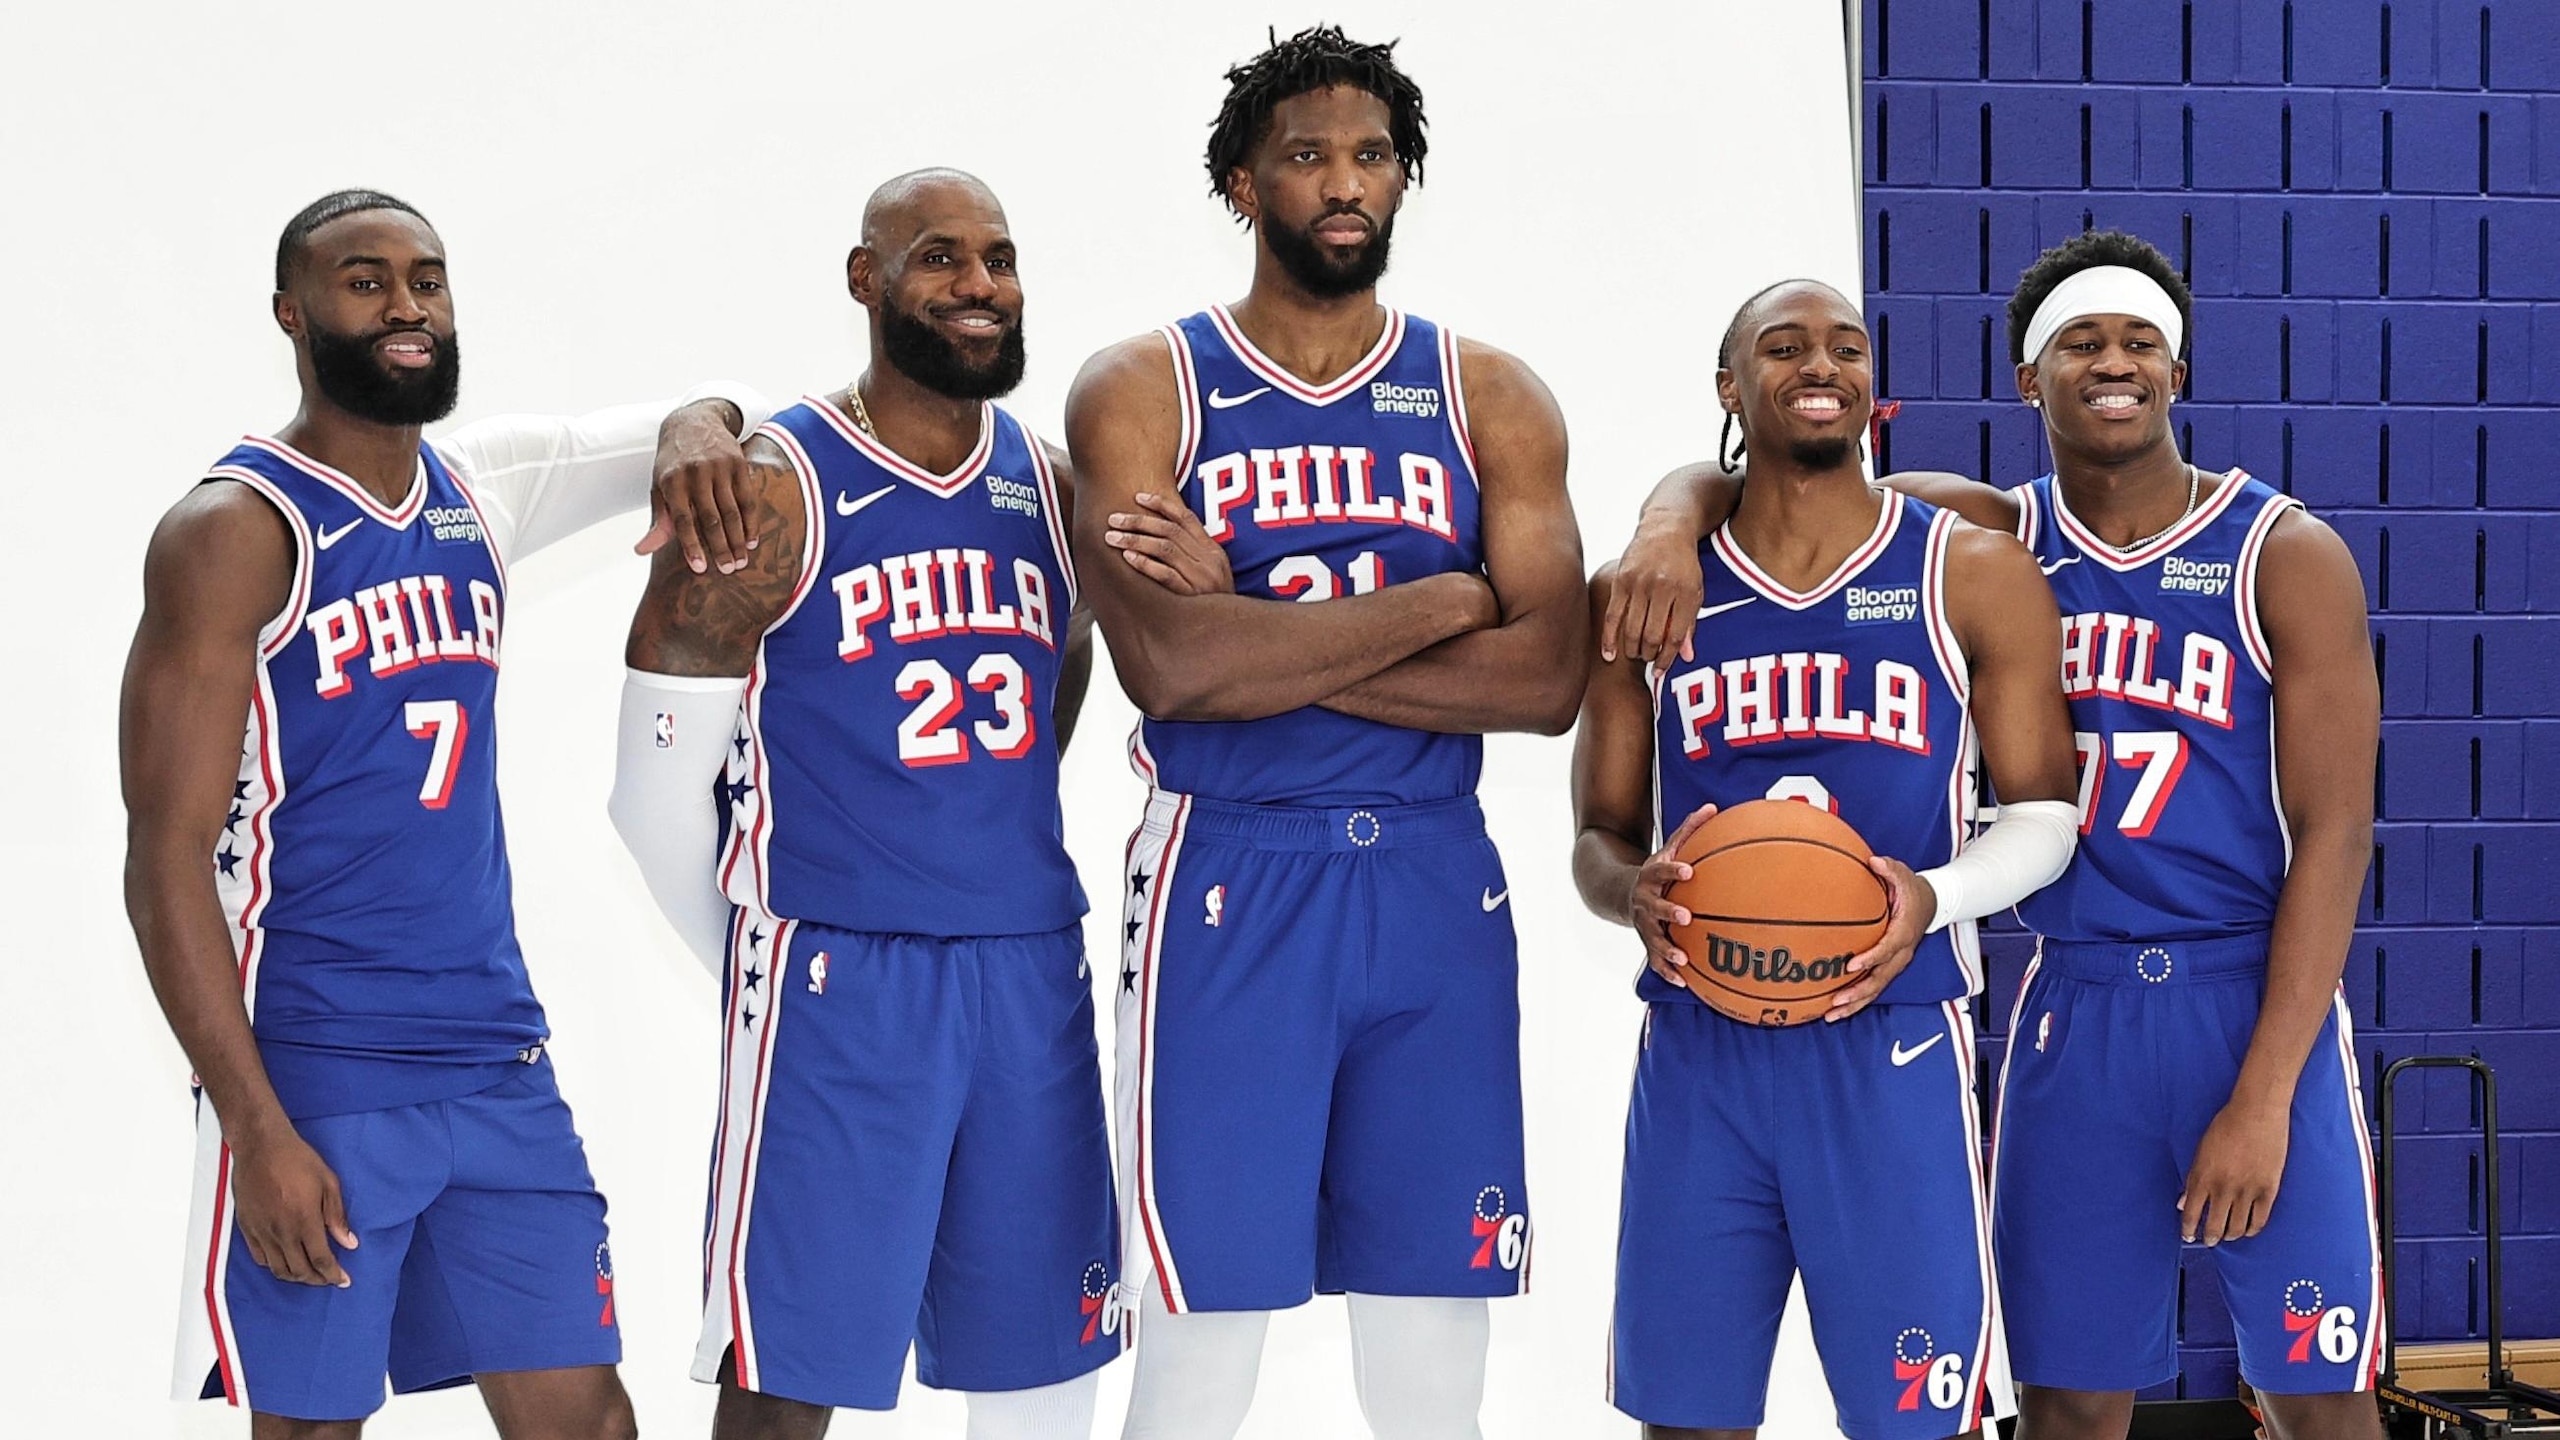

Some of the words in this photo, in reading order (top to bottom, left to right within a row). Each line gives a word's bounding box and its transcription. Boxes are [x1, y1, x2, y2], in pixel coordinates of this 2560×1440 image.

[1371, 382, 1439, 402] Bloom
[1373, 399, 1439, 417] energy
[423, 506, 475, 526] Bloom
[985, 475, 1037, 501] Bloom
[991, 494, 1038, 518] energy
[1197, 444, 1457, 544] PHILA
[433, 523, 482, 542] energy
[2160, 576, 2229, 595] energy
[2163, 557, 2232, 578] Bloom
[832, 548, 1056, 662] PHILA
[1846, 587, 1918, 607] Bloom
[1846, 603, 1918, 621] energy
[305, 574, 500, 700] PHILA
[2061, 612, 2234, 729] HILA
[895, 653, 1035, 768] 23
[1671, 651, 1931, 760] PHILA
[404, 700, 469, 810] 7
[2075, 731, 2189, 838] 77
[1706, 932, 1857, 984] Wilson
[1470, 1213, 1525, 1271] 76
[1080, 1281, 1120, 1346] 76
[2283, 1305, 2359, 1364] 76
[1894, 1352, 1964, 1412] 76
